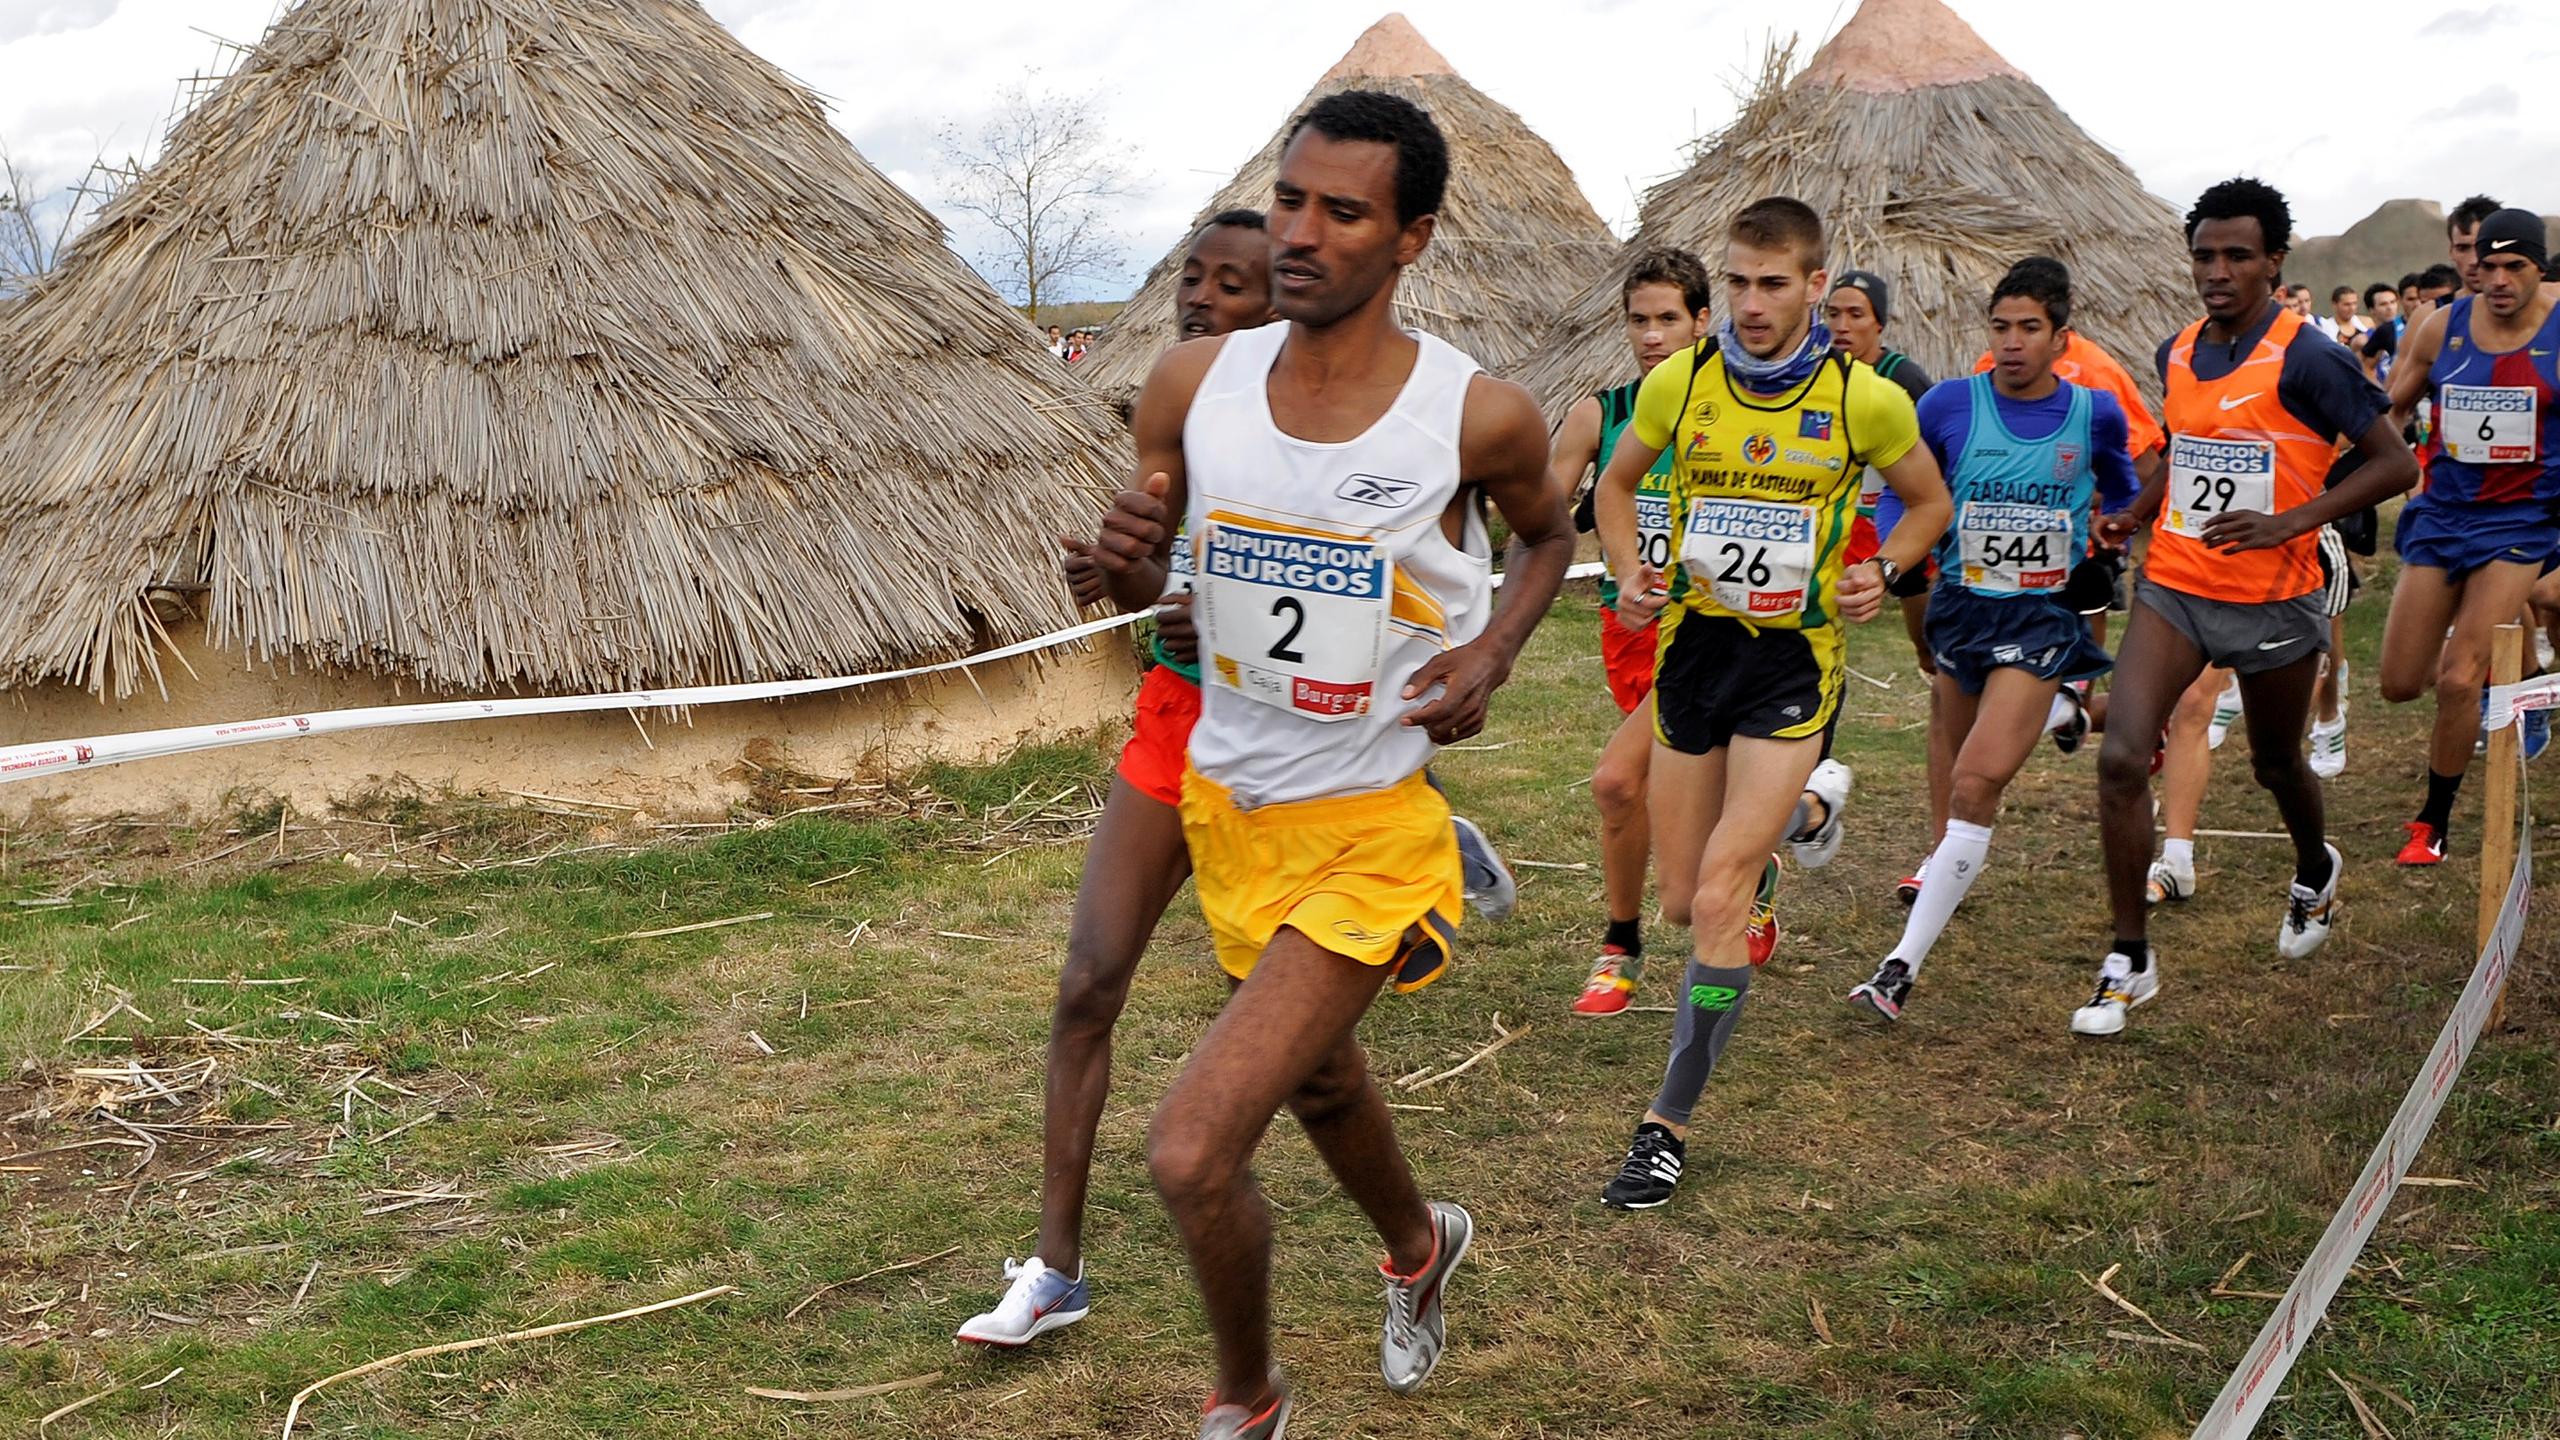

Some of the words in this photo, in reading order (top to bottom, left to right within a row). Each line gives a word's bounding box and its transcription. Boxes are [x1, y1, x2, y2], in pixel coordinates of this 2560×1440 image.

[2448, 390, 2526, 401] DIPUTACION
[2448, 400, 2528, 411] BURGOS
[2477, 415, 2495, 441] 6
[2175, 453, 2264, 472] BURGOS
[2176, 440, 2264, 459] DIPUTACION
[1731, 468, 1748, 489] DE
[1750, 471, 1817, 494] CASTELLON
[2190, 475, 2236, 512] 29
[1699, 504, 1804, 526] DIPUTACION
[1966, 518, 2063, 531] BURGOS
[1693, 517, 1804, 541] BURGOS
[1214, 529, 1375, 569] DIPUTACION
[1981, 535, 2050, 568] 544
[1213, 552, 1373, 595] BURGOS
[1717, 543, 1771, 587] 26
[1267, 596, 1305, 664] 2
